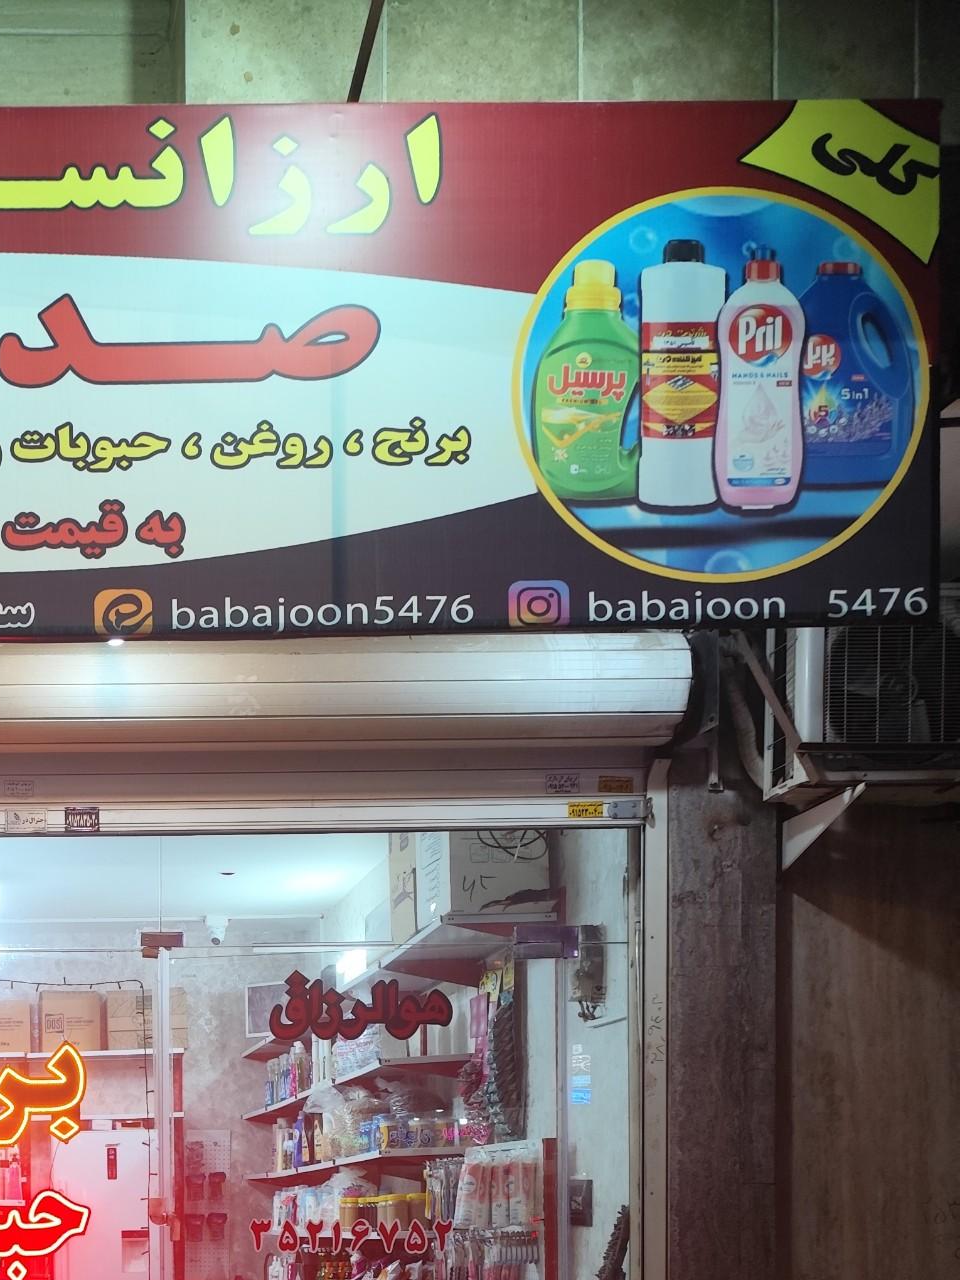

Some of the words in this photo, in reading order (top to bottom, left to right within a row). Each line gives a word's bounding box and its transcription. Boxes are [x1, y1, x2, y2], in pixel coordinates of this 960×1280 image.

[811, 133, 939, 195] کلی
[738, 315, 783, 355] Pril
[547, 363, 627, 403] پرسیل
[11, 422, 171, 472] حبوبات
[210, 419, 333, 470] روغن
[372, 417, 472, 466] برنج
[1, 500, 128, 559] قیمت
[135, 510, 186, 557] به
[171, 594, 475, 632] babajoon5476
[588, 590, 786, 625] babajoon
[827, 587, 928, 618] 5476
